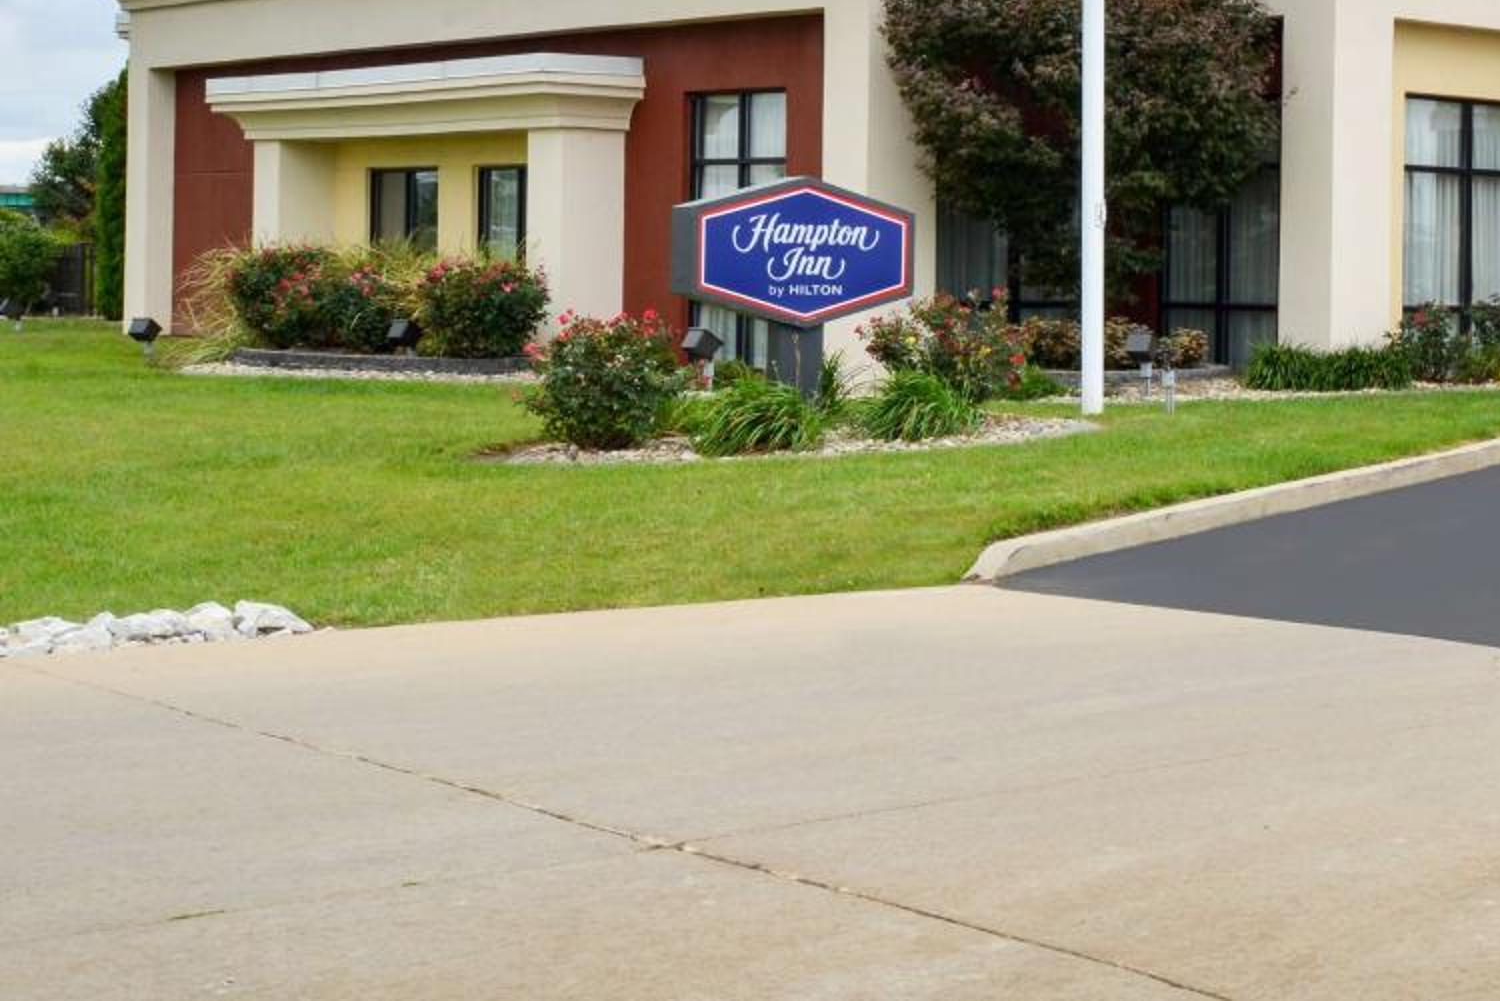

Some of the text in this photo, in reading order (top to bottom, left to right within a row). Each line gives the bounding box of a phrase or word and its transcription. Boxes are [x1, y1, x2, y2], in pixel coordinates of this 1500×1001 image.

[732, 212, 880, 253] Hampton
[766, 247, 845, 281] Inn
[768, 284, 843, 298] by HILTON
